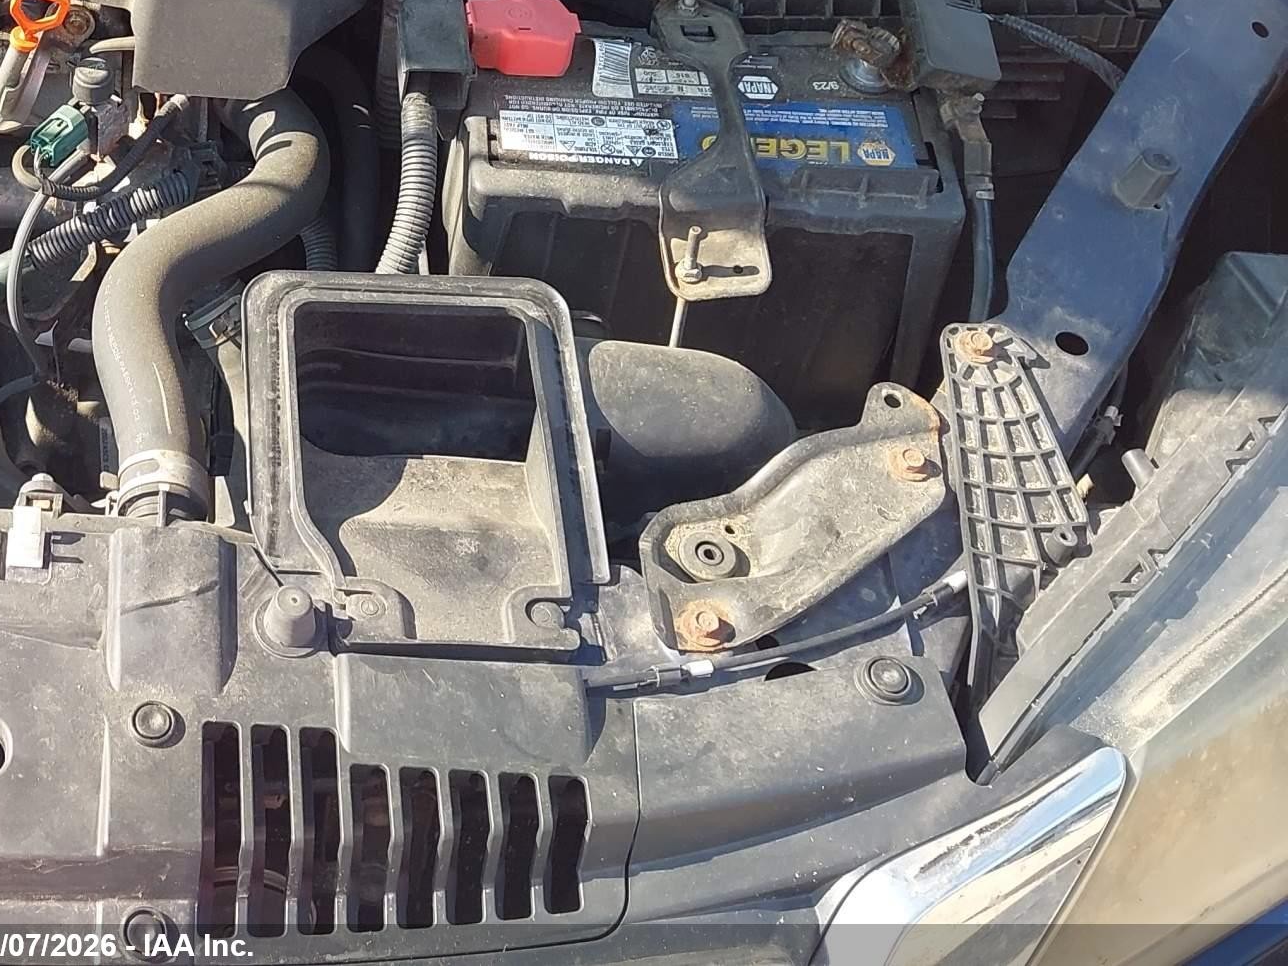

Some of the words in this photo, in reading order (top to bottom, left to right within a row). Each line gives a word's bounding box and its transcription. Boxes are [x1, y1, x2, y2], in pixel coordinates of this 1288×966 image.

[743, 81, 771, 93] NAPA
[812, 80, 839, 91] 9/23
[863, 148, 889, 159] NAPA
